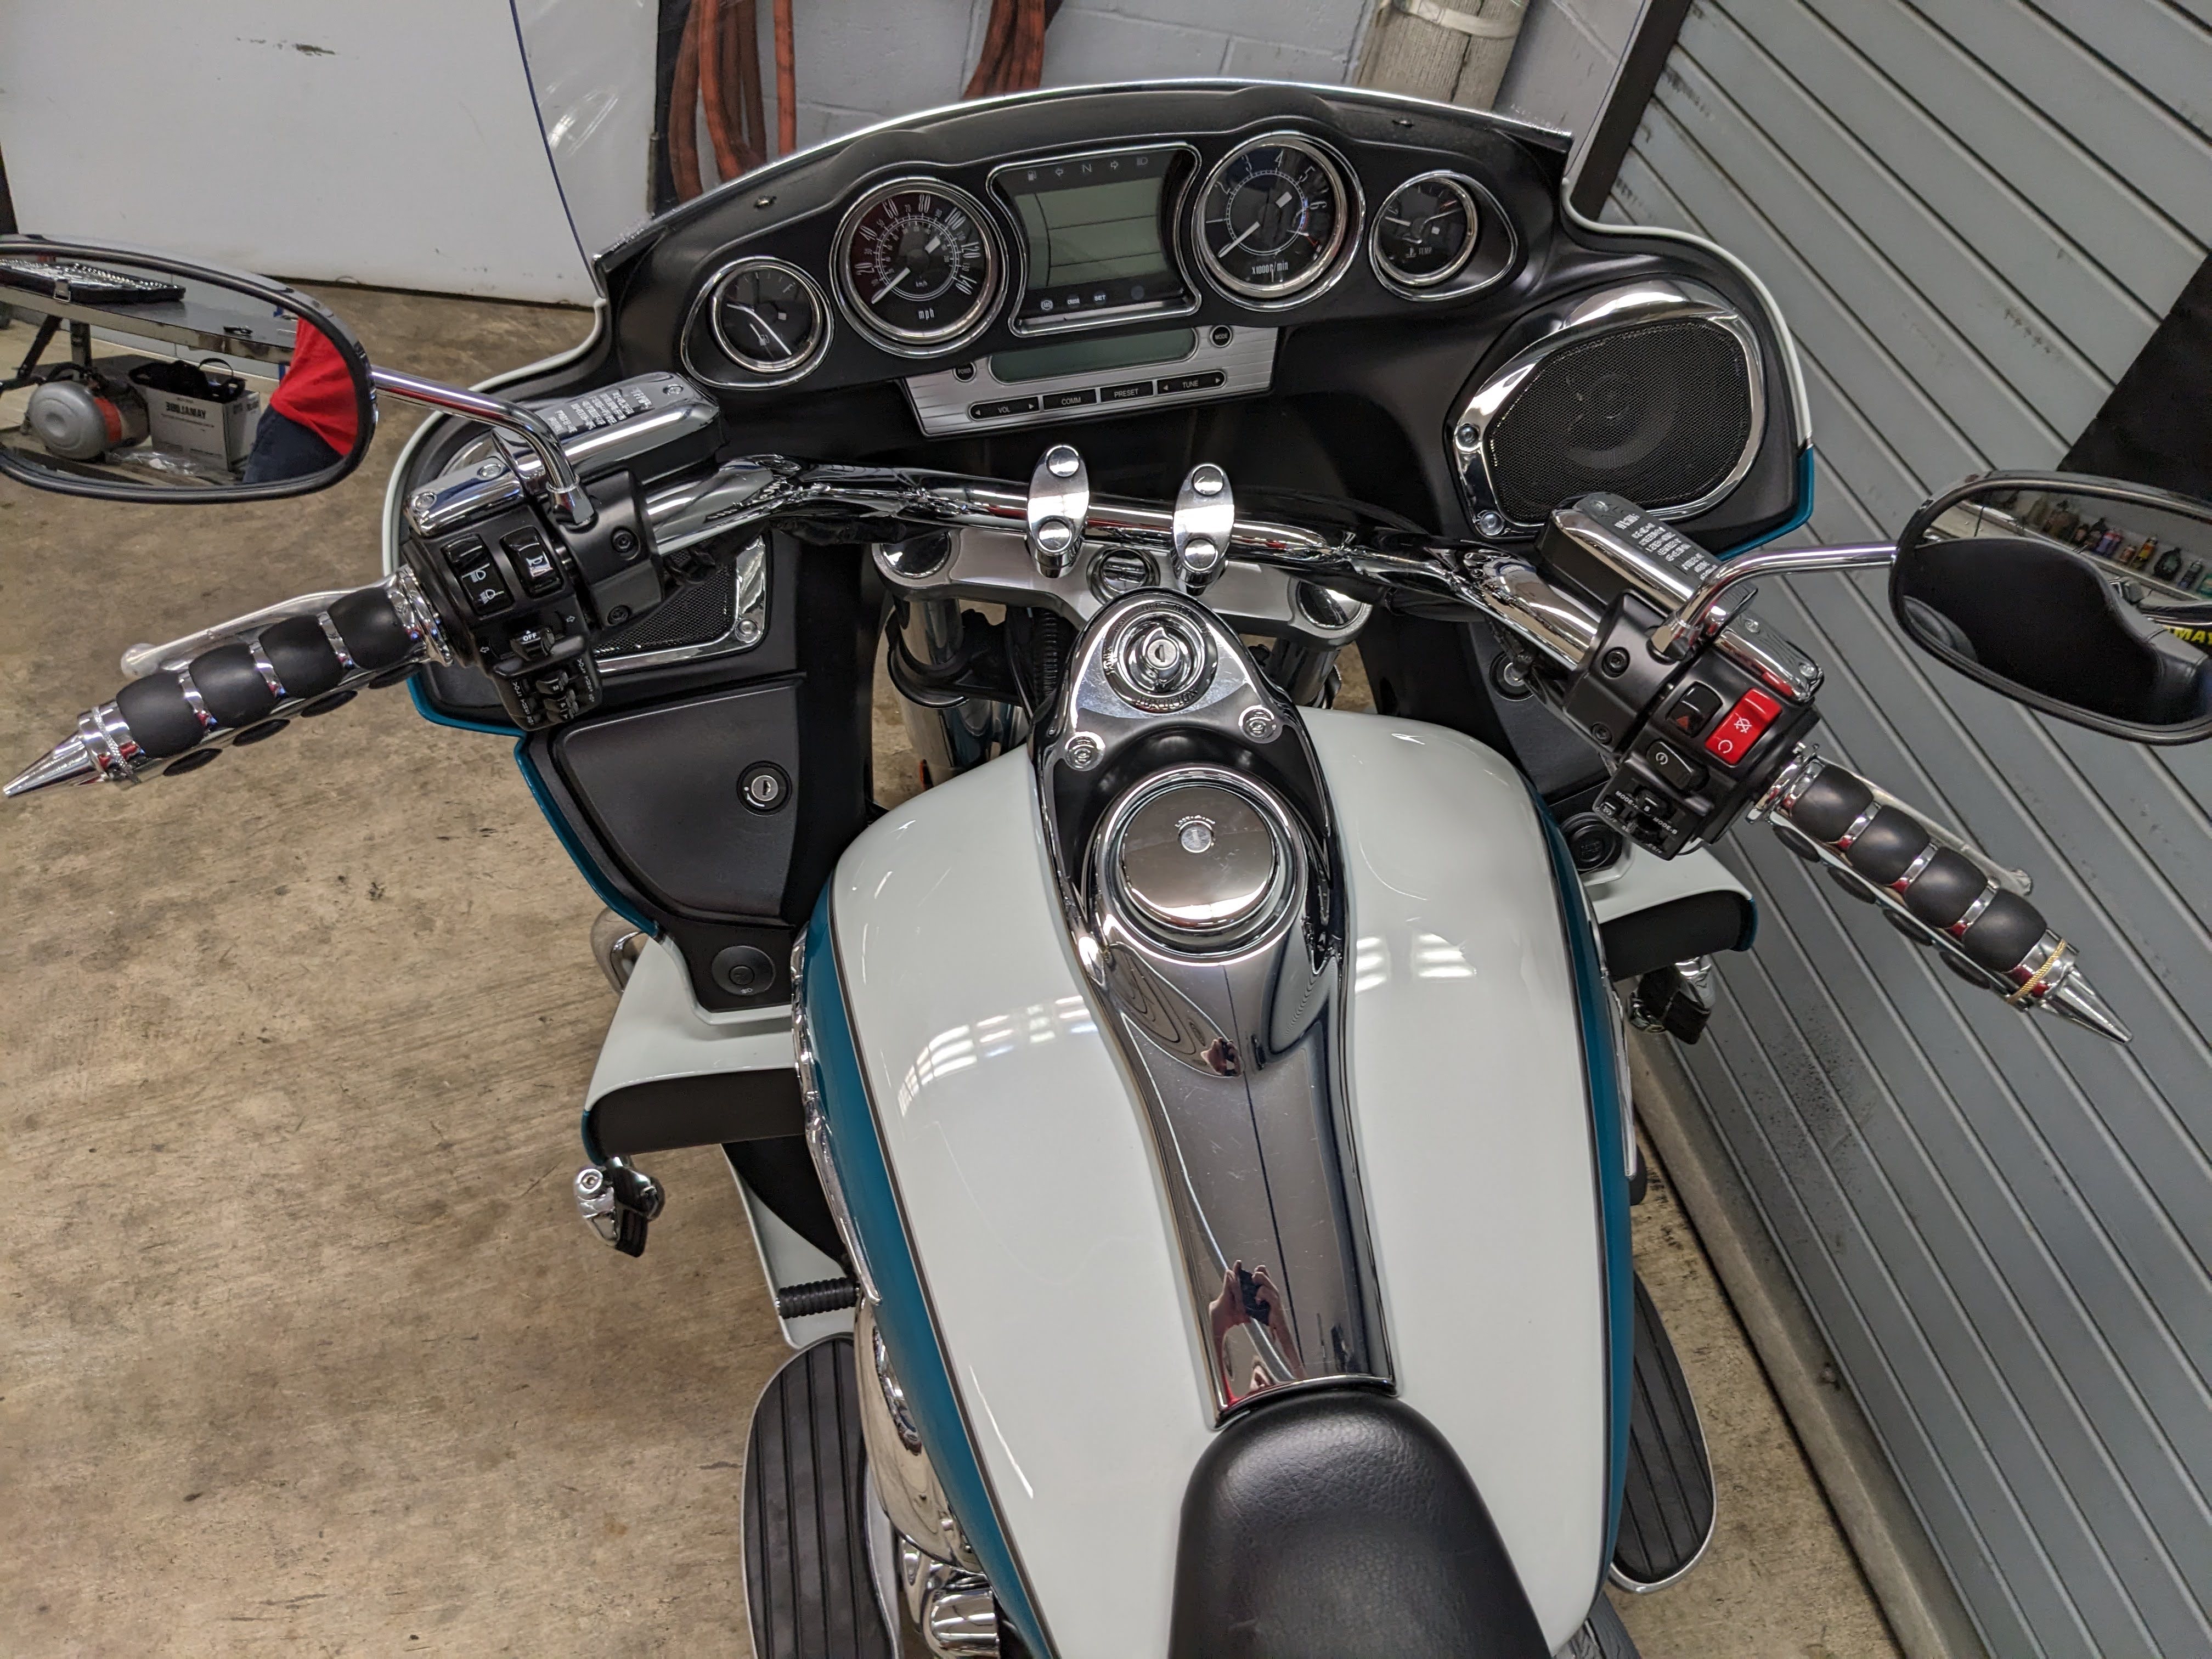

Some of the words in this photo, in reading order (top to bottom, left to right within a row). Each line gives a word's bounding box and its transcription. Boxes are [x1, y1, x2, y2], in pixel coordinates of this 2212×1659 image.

[1275, 150, 1284, 167] 4
[1082, 164, 1092, 173] N
[1299, 166, 1316, 182] 5
[1214, 180, 1231, 194] 2
[882, 198, 899, 219] 60
[918, 194, 930, 213] 80
[1309, 200, 1328, 211] 6
[944, 207, 967, 230] 100
[859, 225, 878, 241] 40
[961, 241, 981, 258] 120
[854, 263, 874, 275] 20
[956, 274, 977, 295] 140
[918, 308, 934, 320] mph
[1214, 332, 1229, 341] MODE
[957, 367, 972, 375] POWER
[1182, 379, 1199, 388] TUNE
[1114, 388, 1138, 398] PRESET
[1061, 396, 1081, 406] COMM
[998, 405, 1011, 414] VOL
[523, 633, 537, 641] OFF
[1136, 687, 1198, 710] IGNITION
